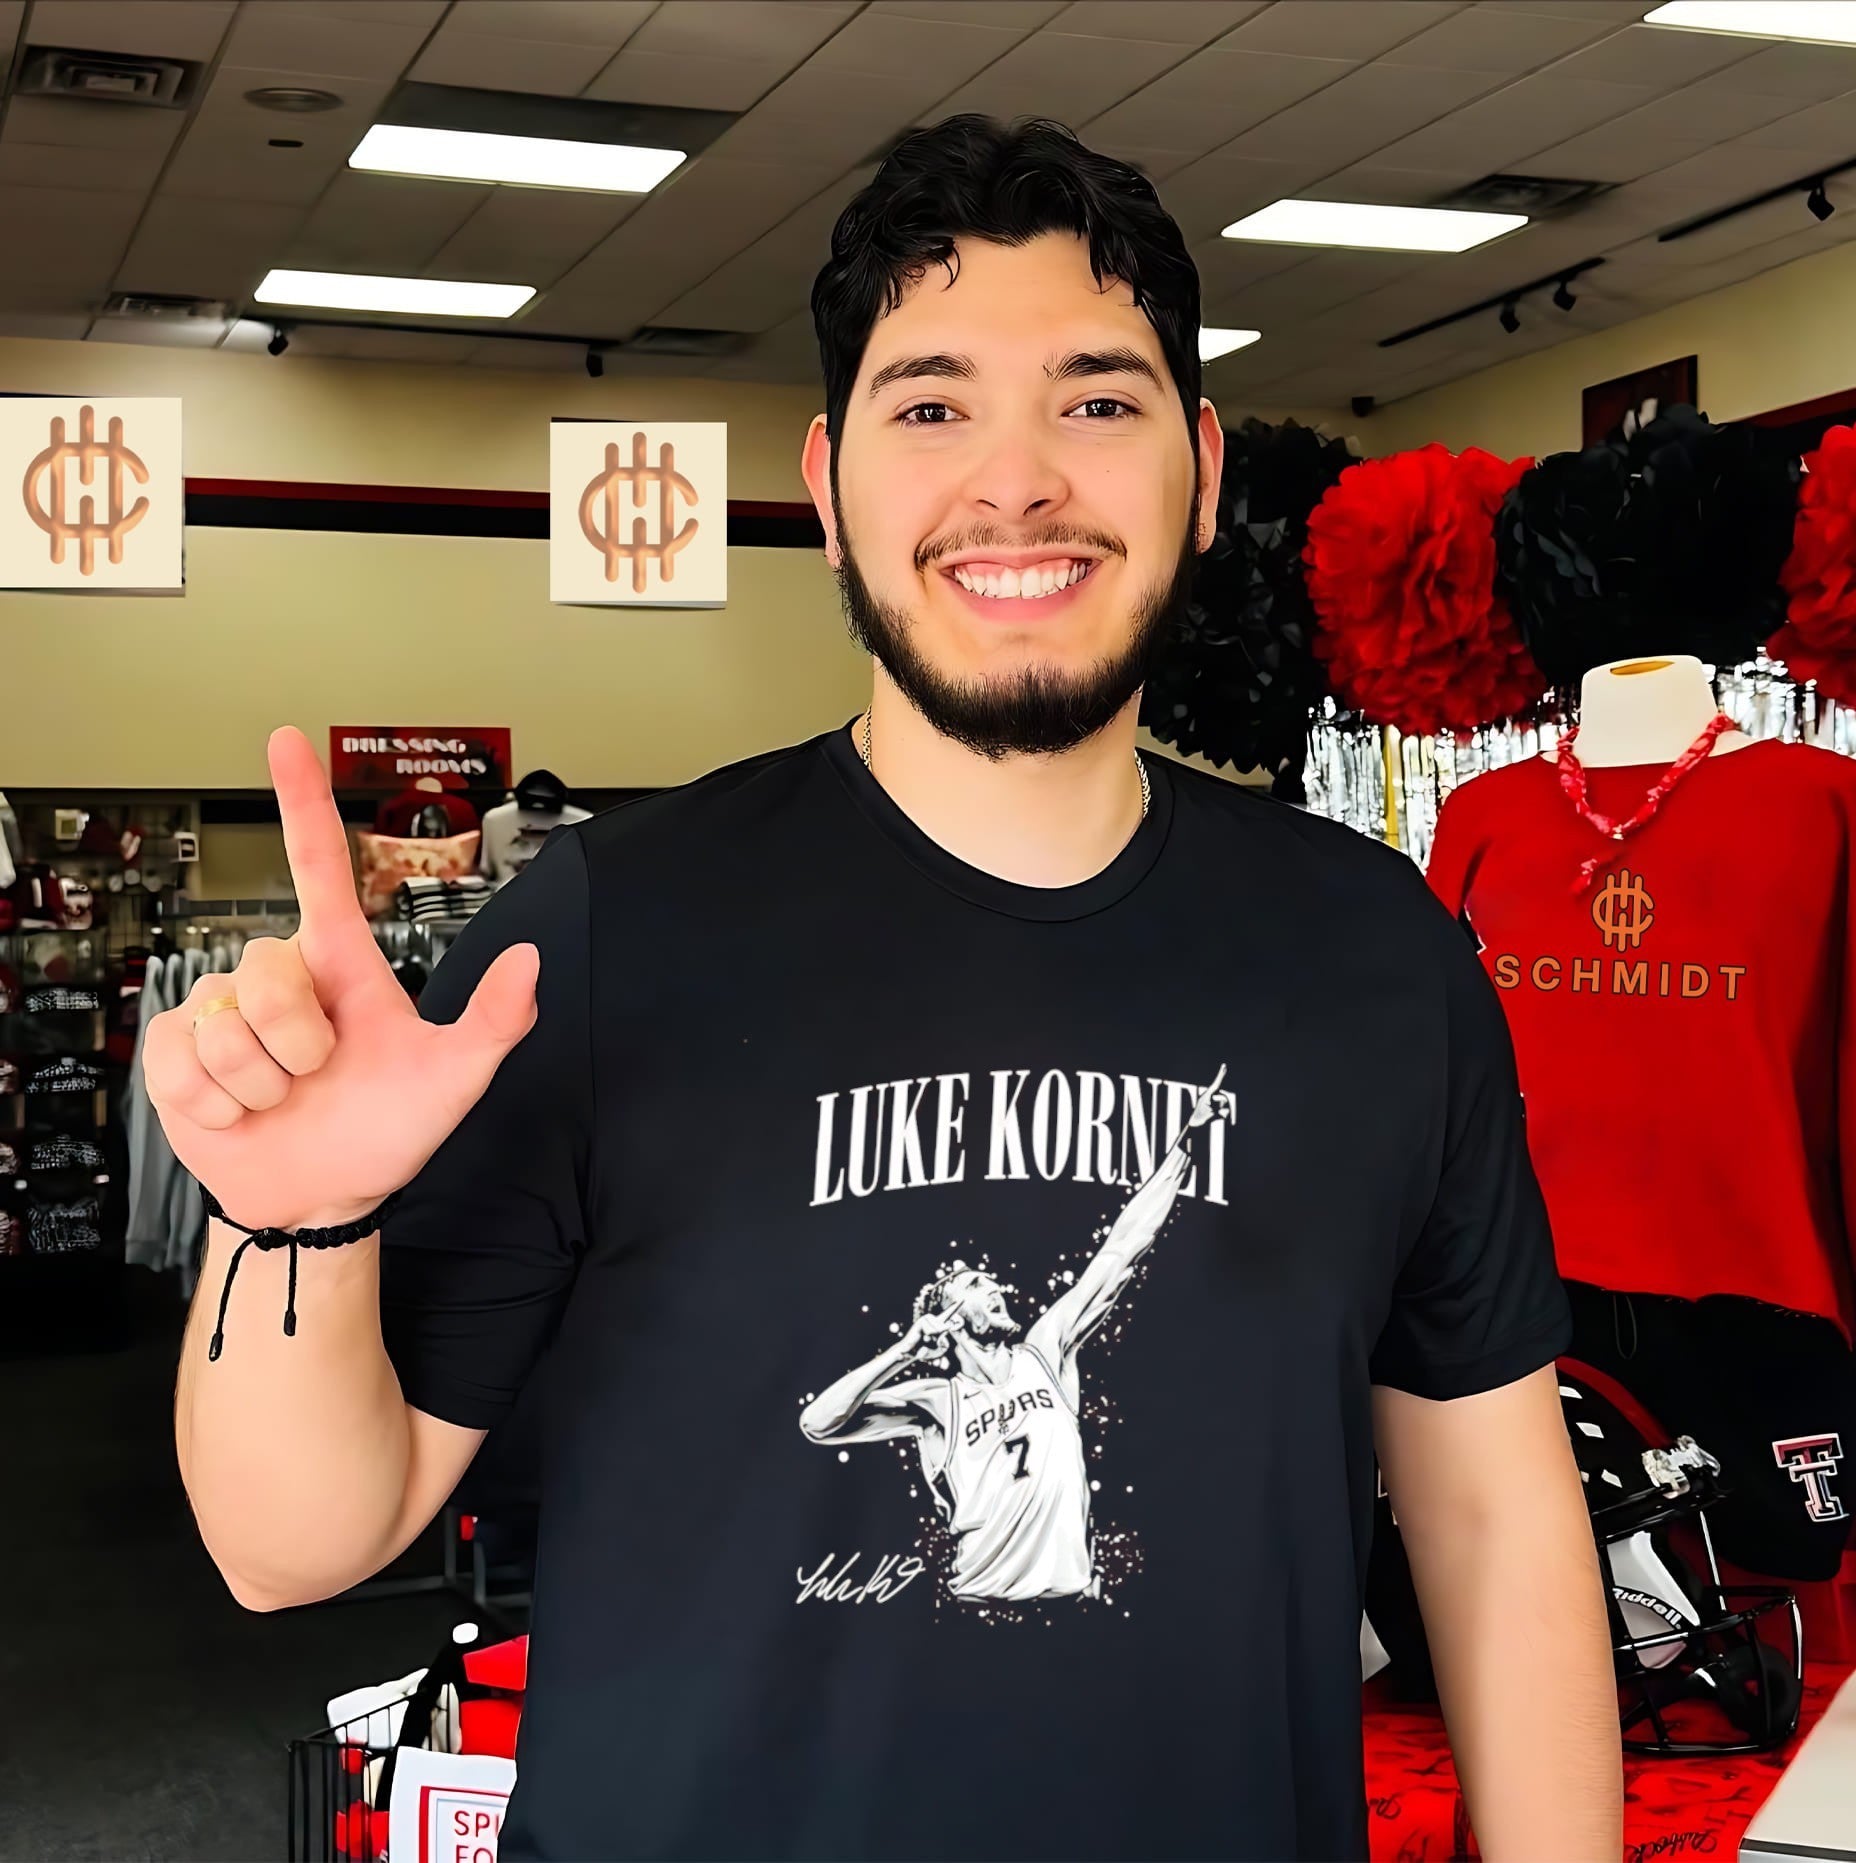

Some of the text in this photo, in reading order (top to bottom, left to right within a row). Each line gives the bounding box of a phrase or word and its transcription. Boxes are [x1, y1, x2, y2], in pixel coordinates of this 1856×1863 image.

[396, 758, 487, 775] ROOMS
[1494, 954, 1746, 1000] SCHMIDT
[809, 1068, 1237, 1206] LUKE KORNET
[965, 1388, 1055, 1447] SPURS
[1004, 1433, 1030, 1481] 7
